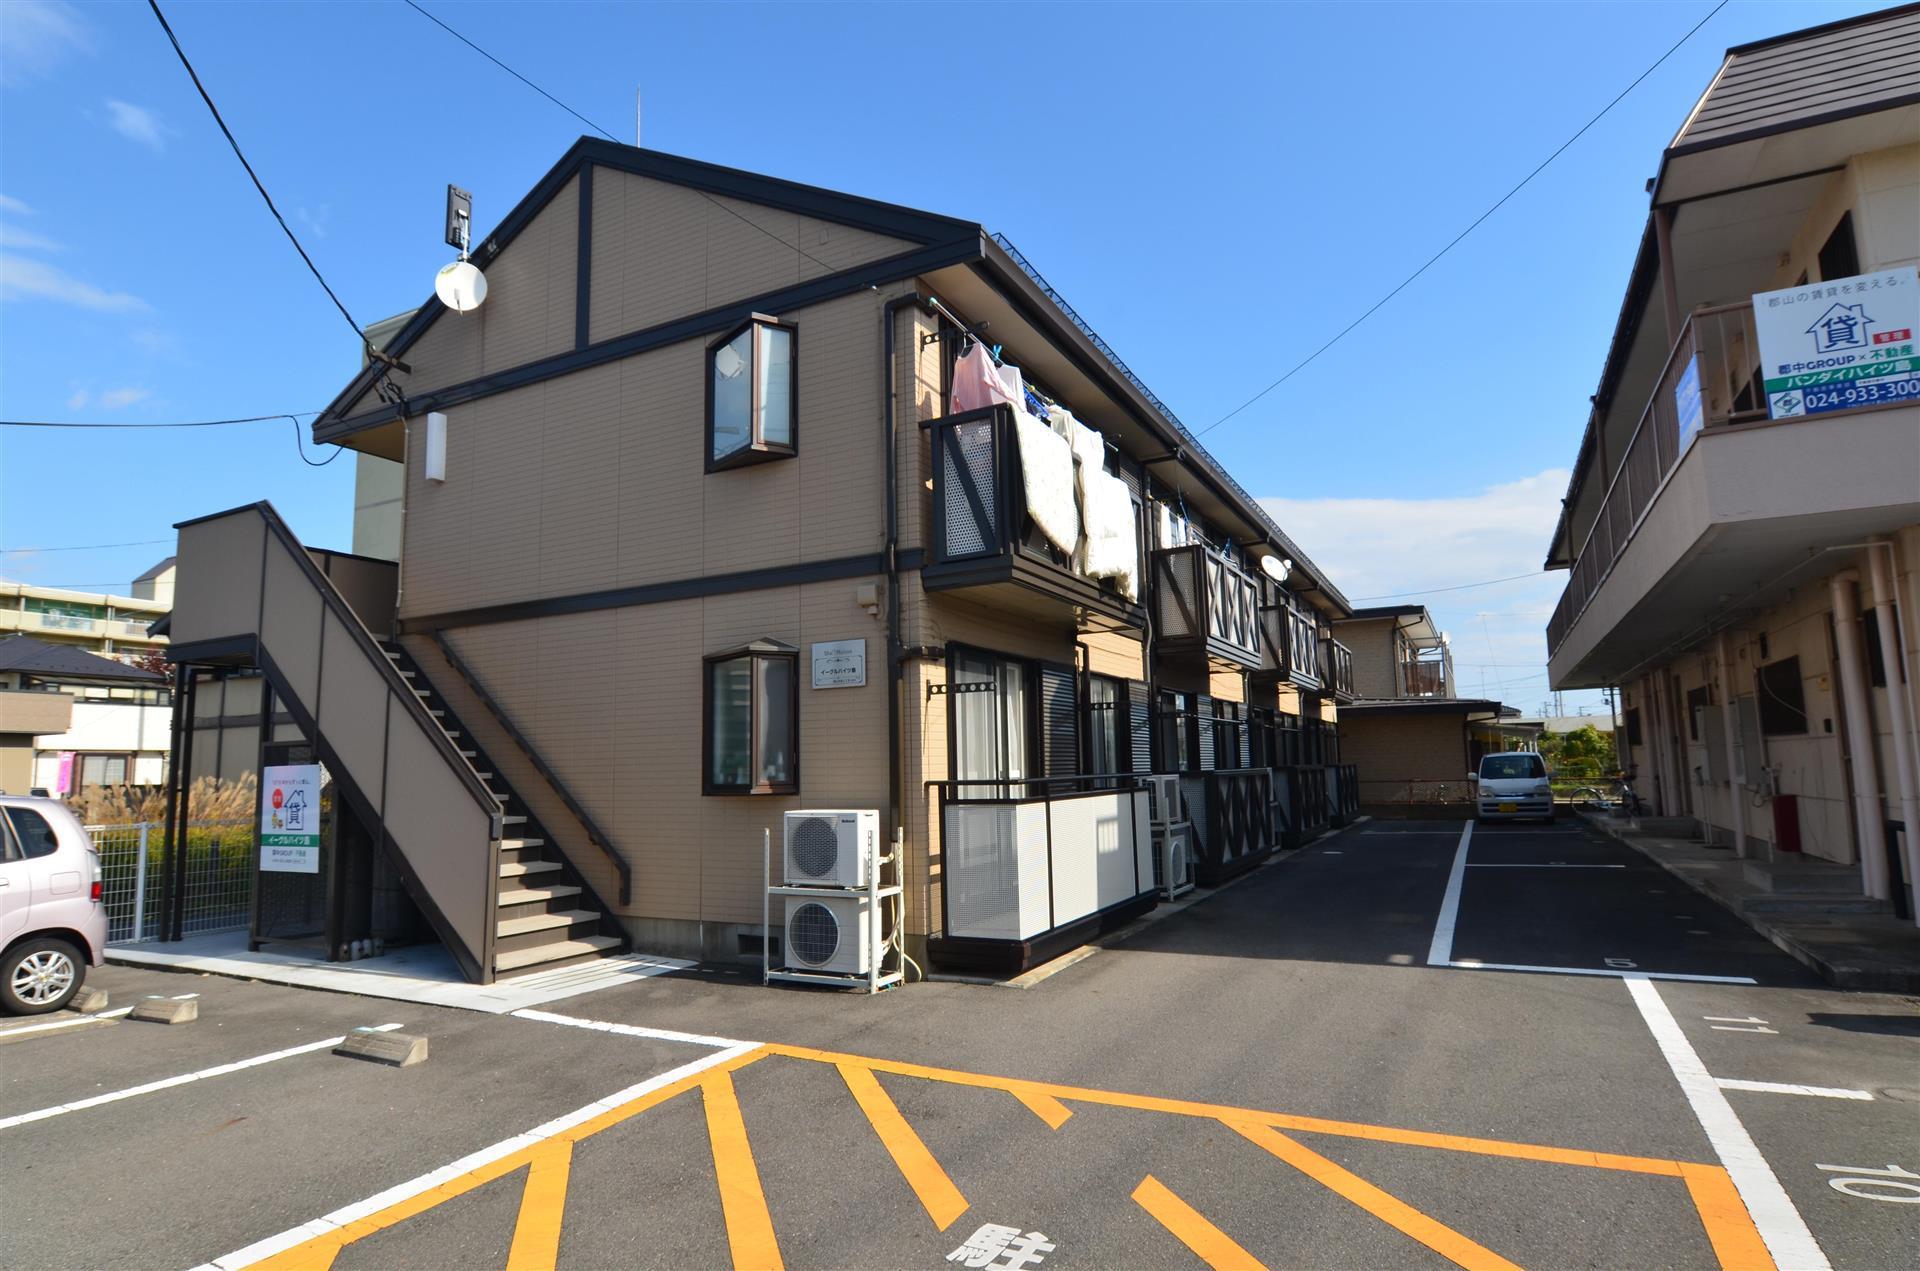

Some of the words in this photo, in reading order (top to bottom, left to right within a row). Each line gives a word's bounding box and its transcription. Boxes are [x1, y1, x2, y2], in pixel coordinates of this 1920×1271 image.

[1820, 314, 1860, 349] 貸
[288, 802, 302, 824] 貸
[1603, 957, 1638, 968] 5
[1703, 1016, 1779, 1034] 11
[1814, 1163, 1920, 1203] 10
